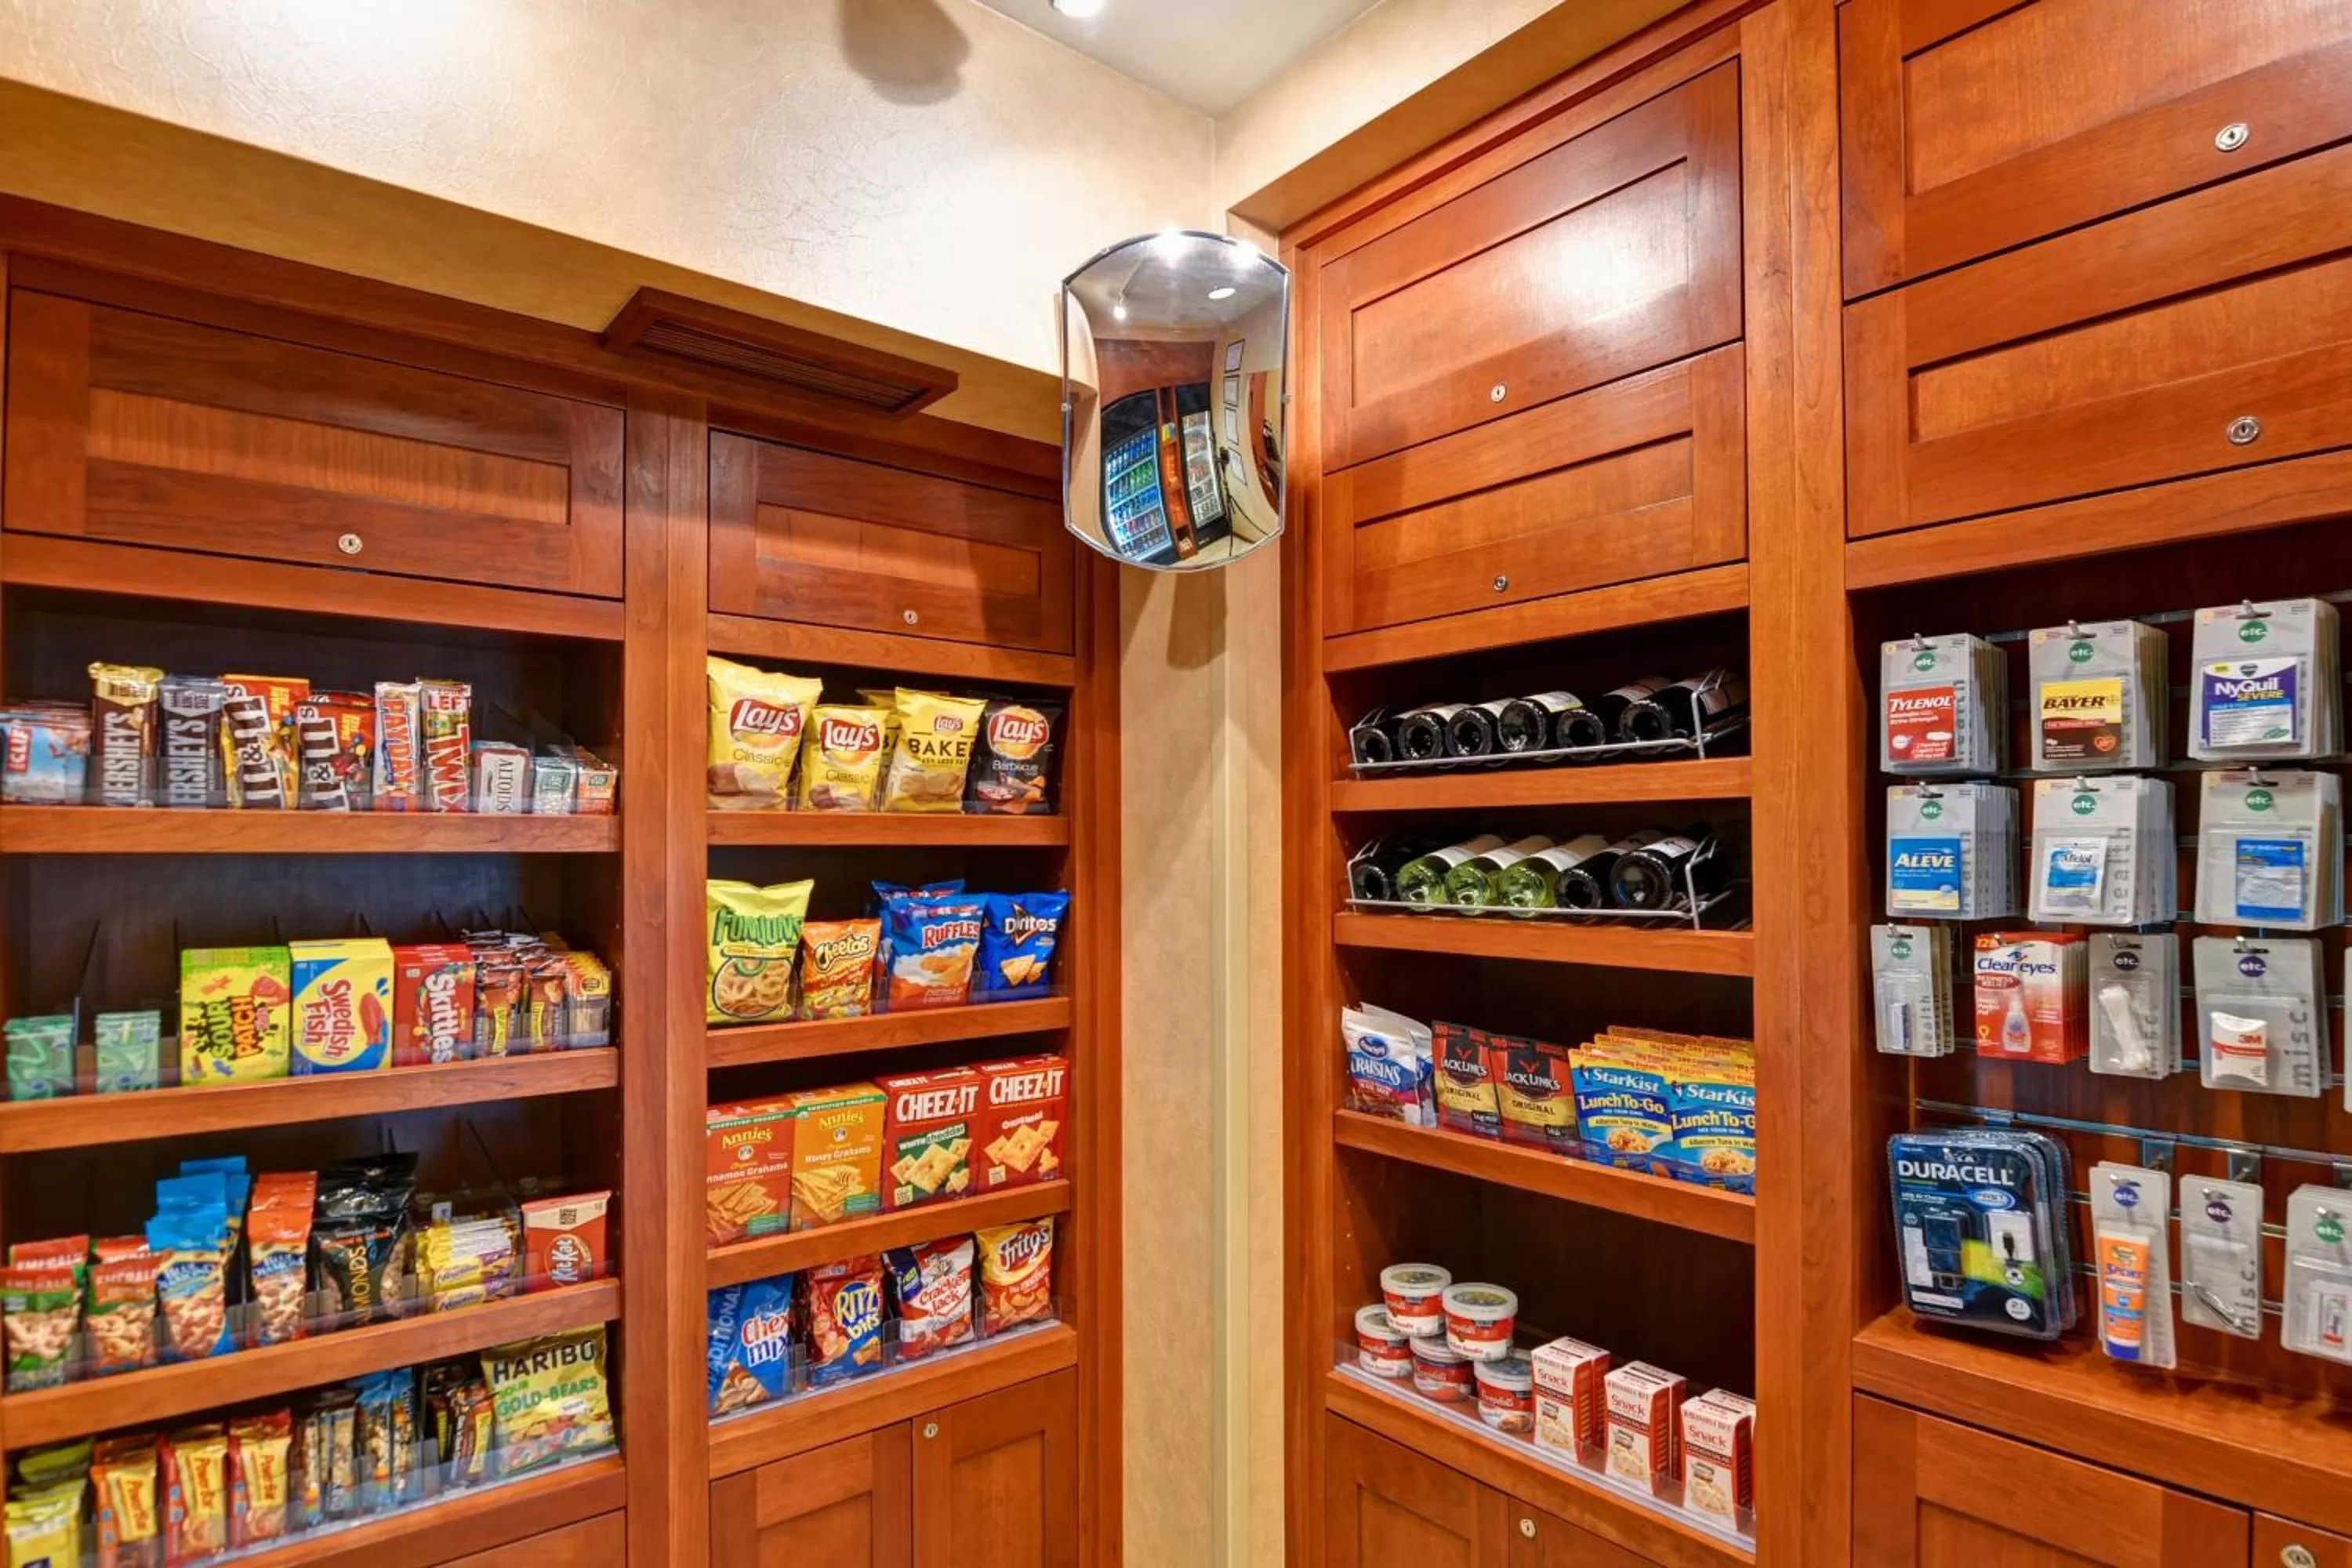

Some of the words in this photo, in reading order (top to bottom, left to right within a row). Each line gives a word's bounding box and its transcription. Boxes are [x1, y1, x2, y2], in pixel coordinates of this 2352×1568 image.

[2214, 677, 2278, 699] NyQuil
[2237, 690, 2284, 702] SEVERE
[1889, 695, 1955, 712] TYLENOL
[2043, 695, 2106, 710] BAYER
[733, 700, 800, 735] Lay's
[993, 715, 1045, 743] Lay's
[9, 729, 30, 764] CLIF
[381, 698, 416, 786] PAYDAY
[824, 720, 877, 750] Lay's
[169, 719, 206, 803] ERSHEY'S
[426, 723, 470, 812] TWIX
[733, 749, 782, 766] Classic
[497, 758, 514, 812] ALTOIDS
[826, 769, 871, 783] Classic
[1894, 851, 1955, 868] ALEVE
[815, 935, 871, 971] Cheetos
[1977, 957, 2018, 971] Clear
[2019, 962, 2058, 977] eyes
[2114, 956, 2140, 966] etc.
[2239, 961, 2267, 971] etc.
[205, 1000, 234, 1062] SOUR
[233, 996, 263, 1058] PATCH
[304, 1002, 331, 1045] Fish
[321, 978, 357, 1058] Swedish
[426, 974, 459, 1063] Skittles
[2238, 1034, 2263, 1045] 3M
[2283, 998, 2312, 1087] misc.
[1592, 1068, 1659, 1094] StarKist
[1686, 1083, 1755, 1106] StarKis
[818, 1109, 866, 1129] Annie's
[1718, 1111, 1755, 1129] To-G
[721, 1127, 774, 1149] Annie's
[1740, 1138, 1755, 1148] Wat
[1897, 1160, 2015, 1187] DURACELL
[998, 1226, 1050, 1271] Fritos
[834, 1284, 880, 1327] RITZ
[492, 1339, 596, 1383] HARIBO
[497, 1377, 598, 1417] GOLD-BEARS
